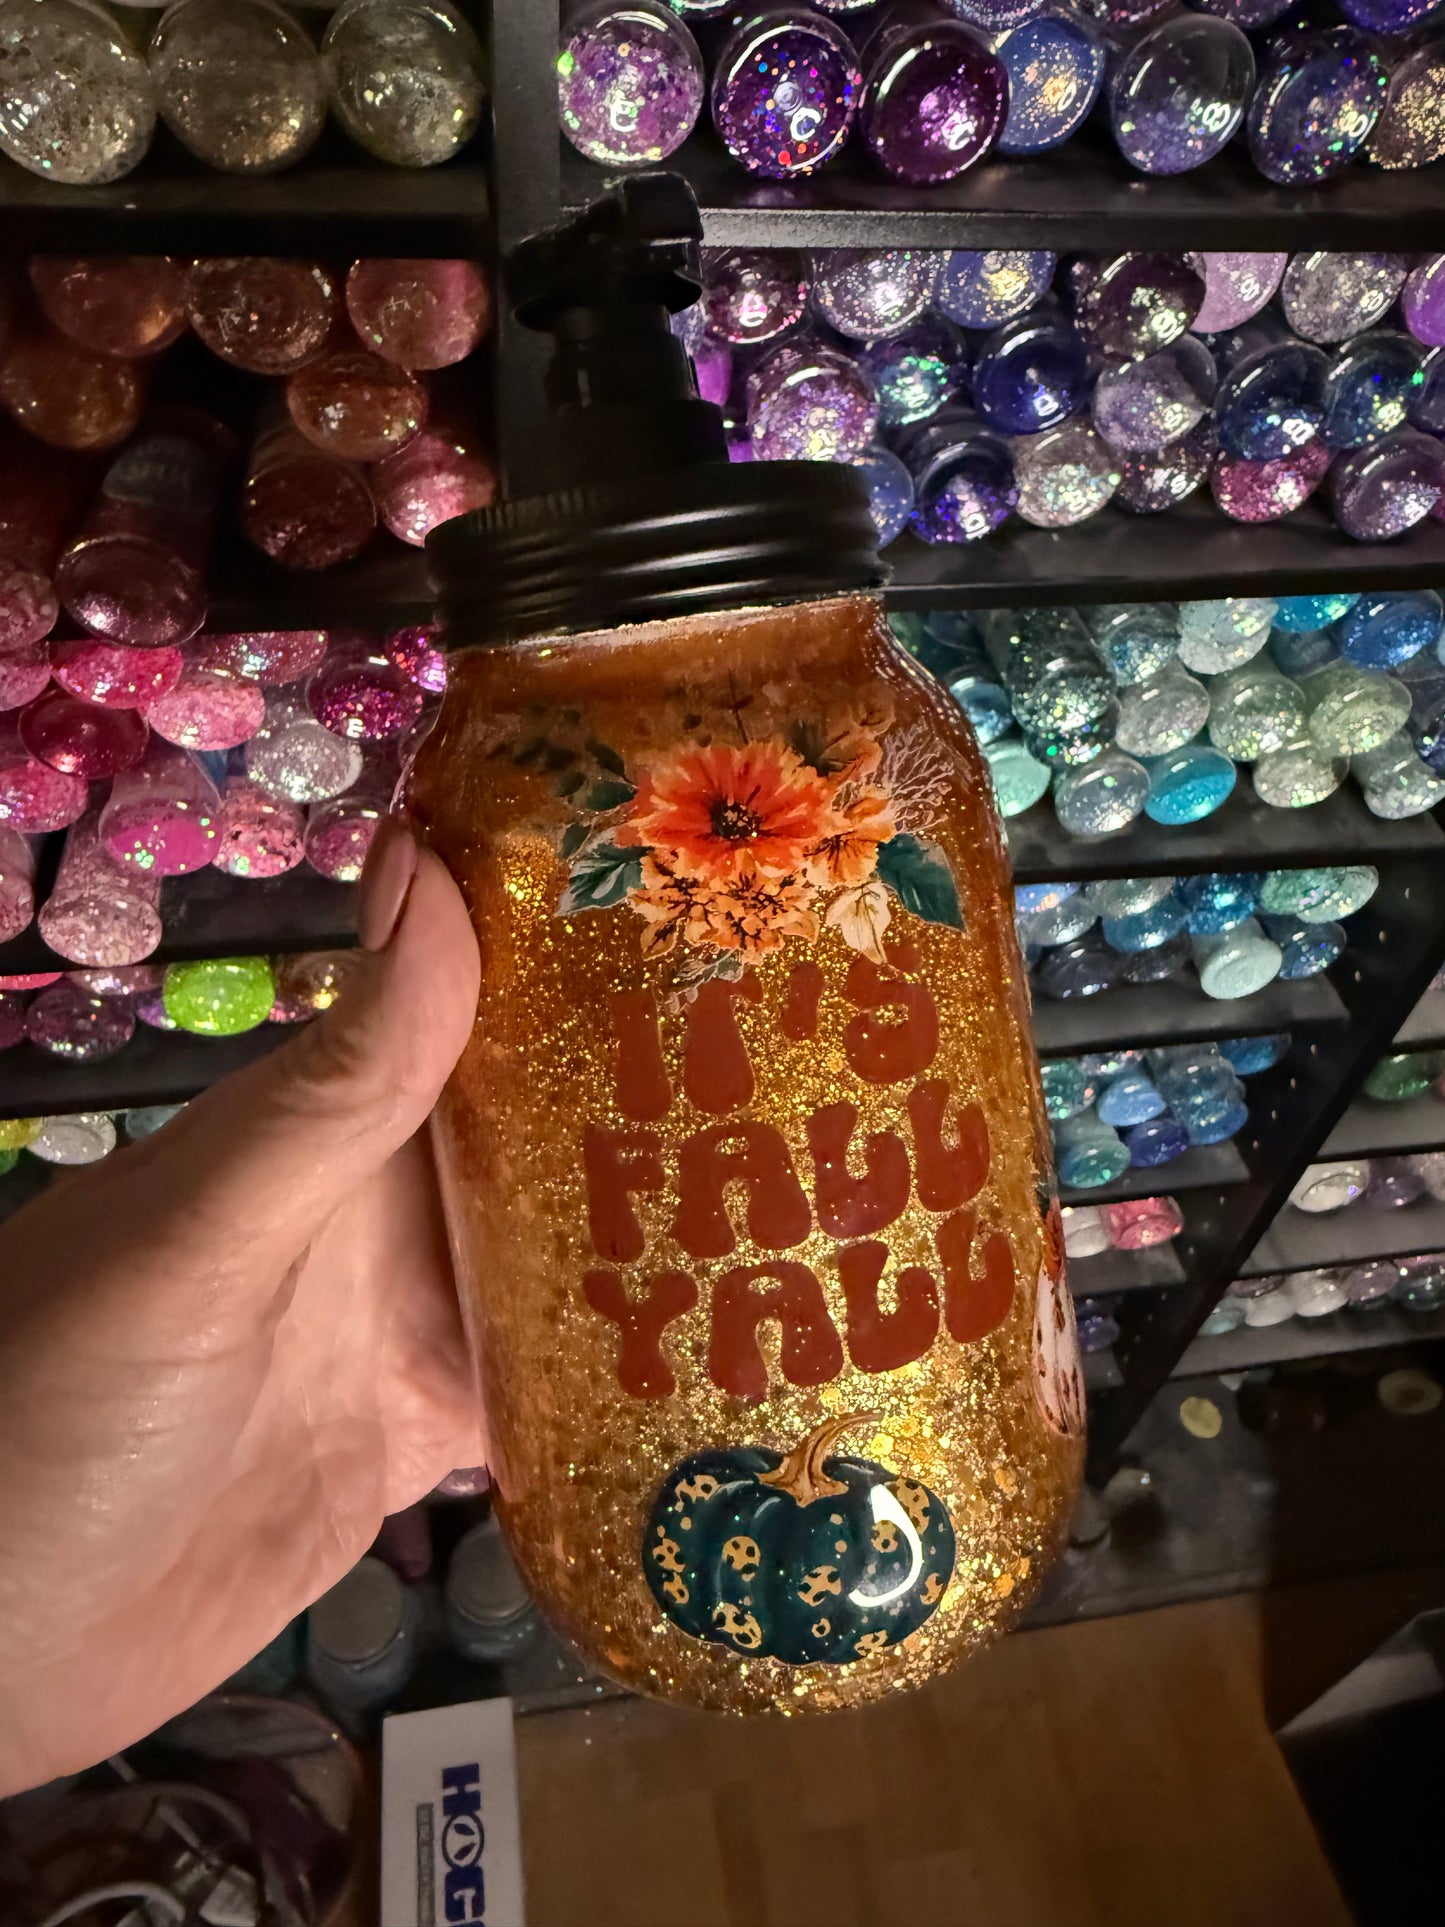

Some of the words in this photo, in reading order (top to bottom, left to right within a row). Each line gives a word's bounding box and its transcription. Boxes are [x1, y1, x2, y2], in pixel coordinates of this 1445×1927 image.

[585, 1079, 990, 1260] FALL
[583, 1214, 1015, 1402] YALL
[441, 1763, 486, 1927] HOG
